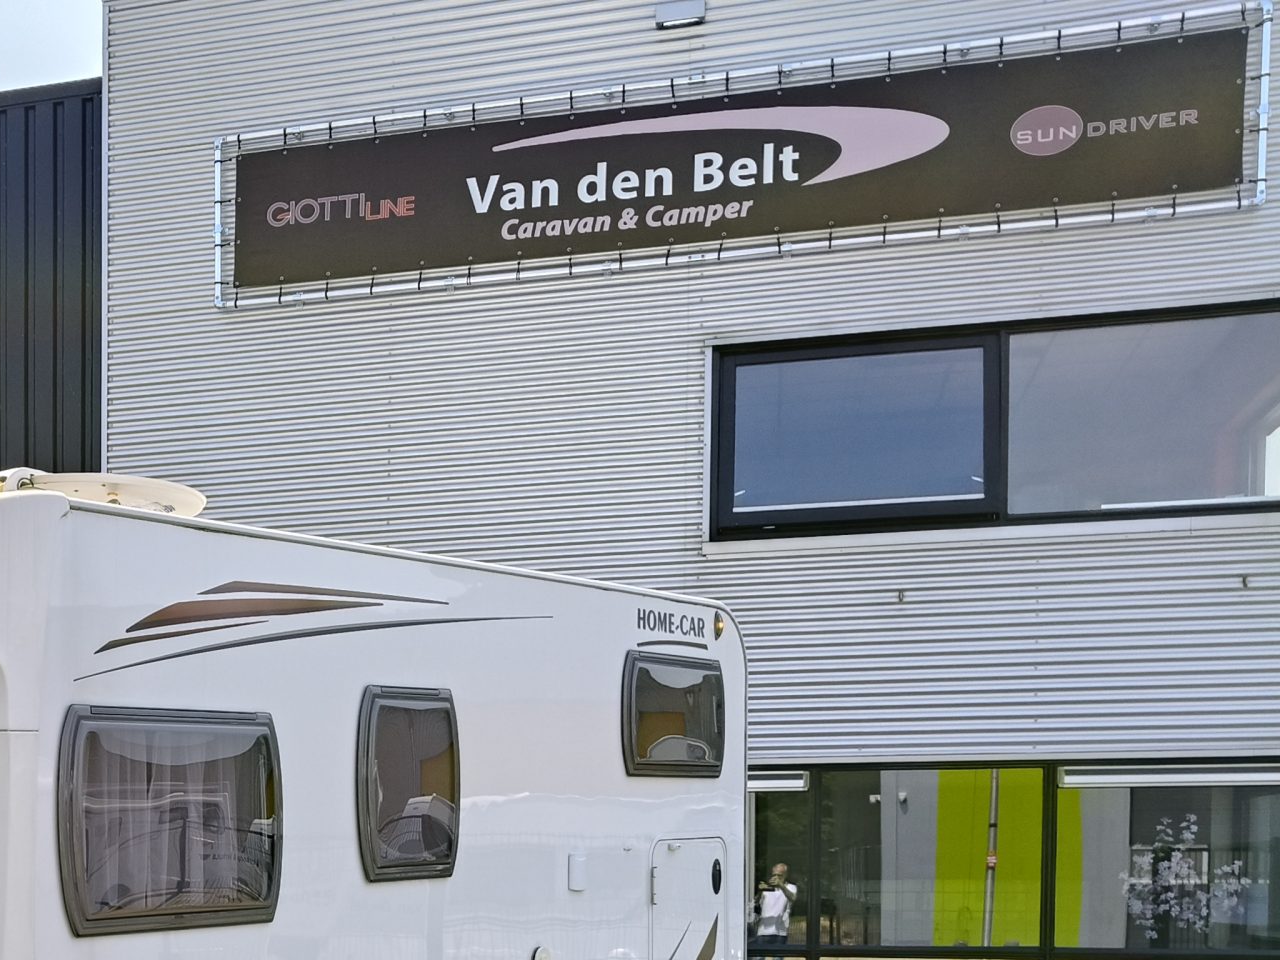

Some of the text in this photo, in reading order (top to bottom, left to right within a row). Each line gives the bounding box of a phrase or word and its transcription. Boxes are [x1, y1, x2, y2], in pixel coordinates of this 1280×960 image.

[1016, 109, 1199, 145] SUN DRIVER
[466, 142, 800, 214] Van den Belt
[501, 199, 754, 241] Caravan & Camper
[637, 607, 705, 639] HOME-CAR
